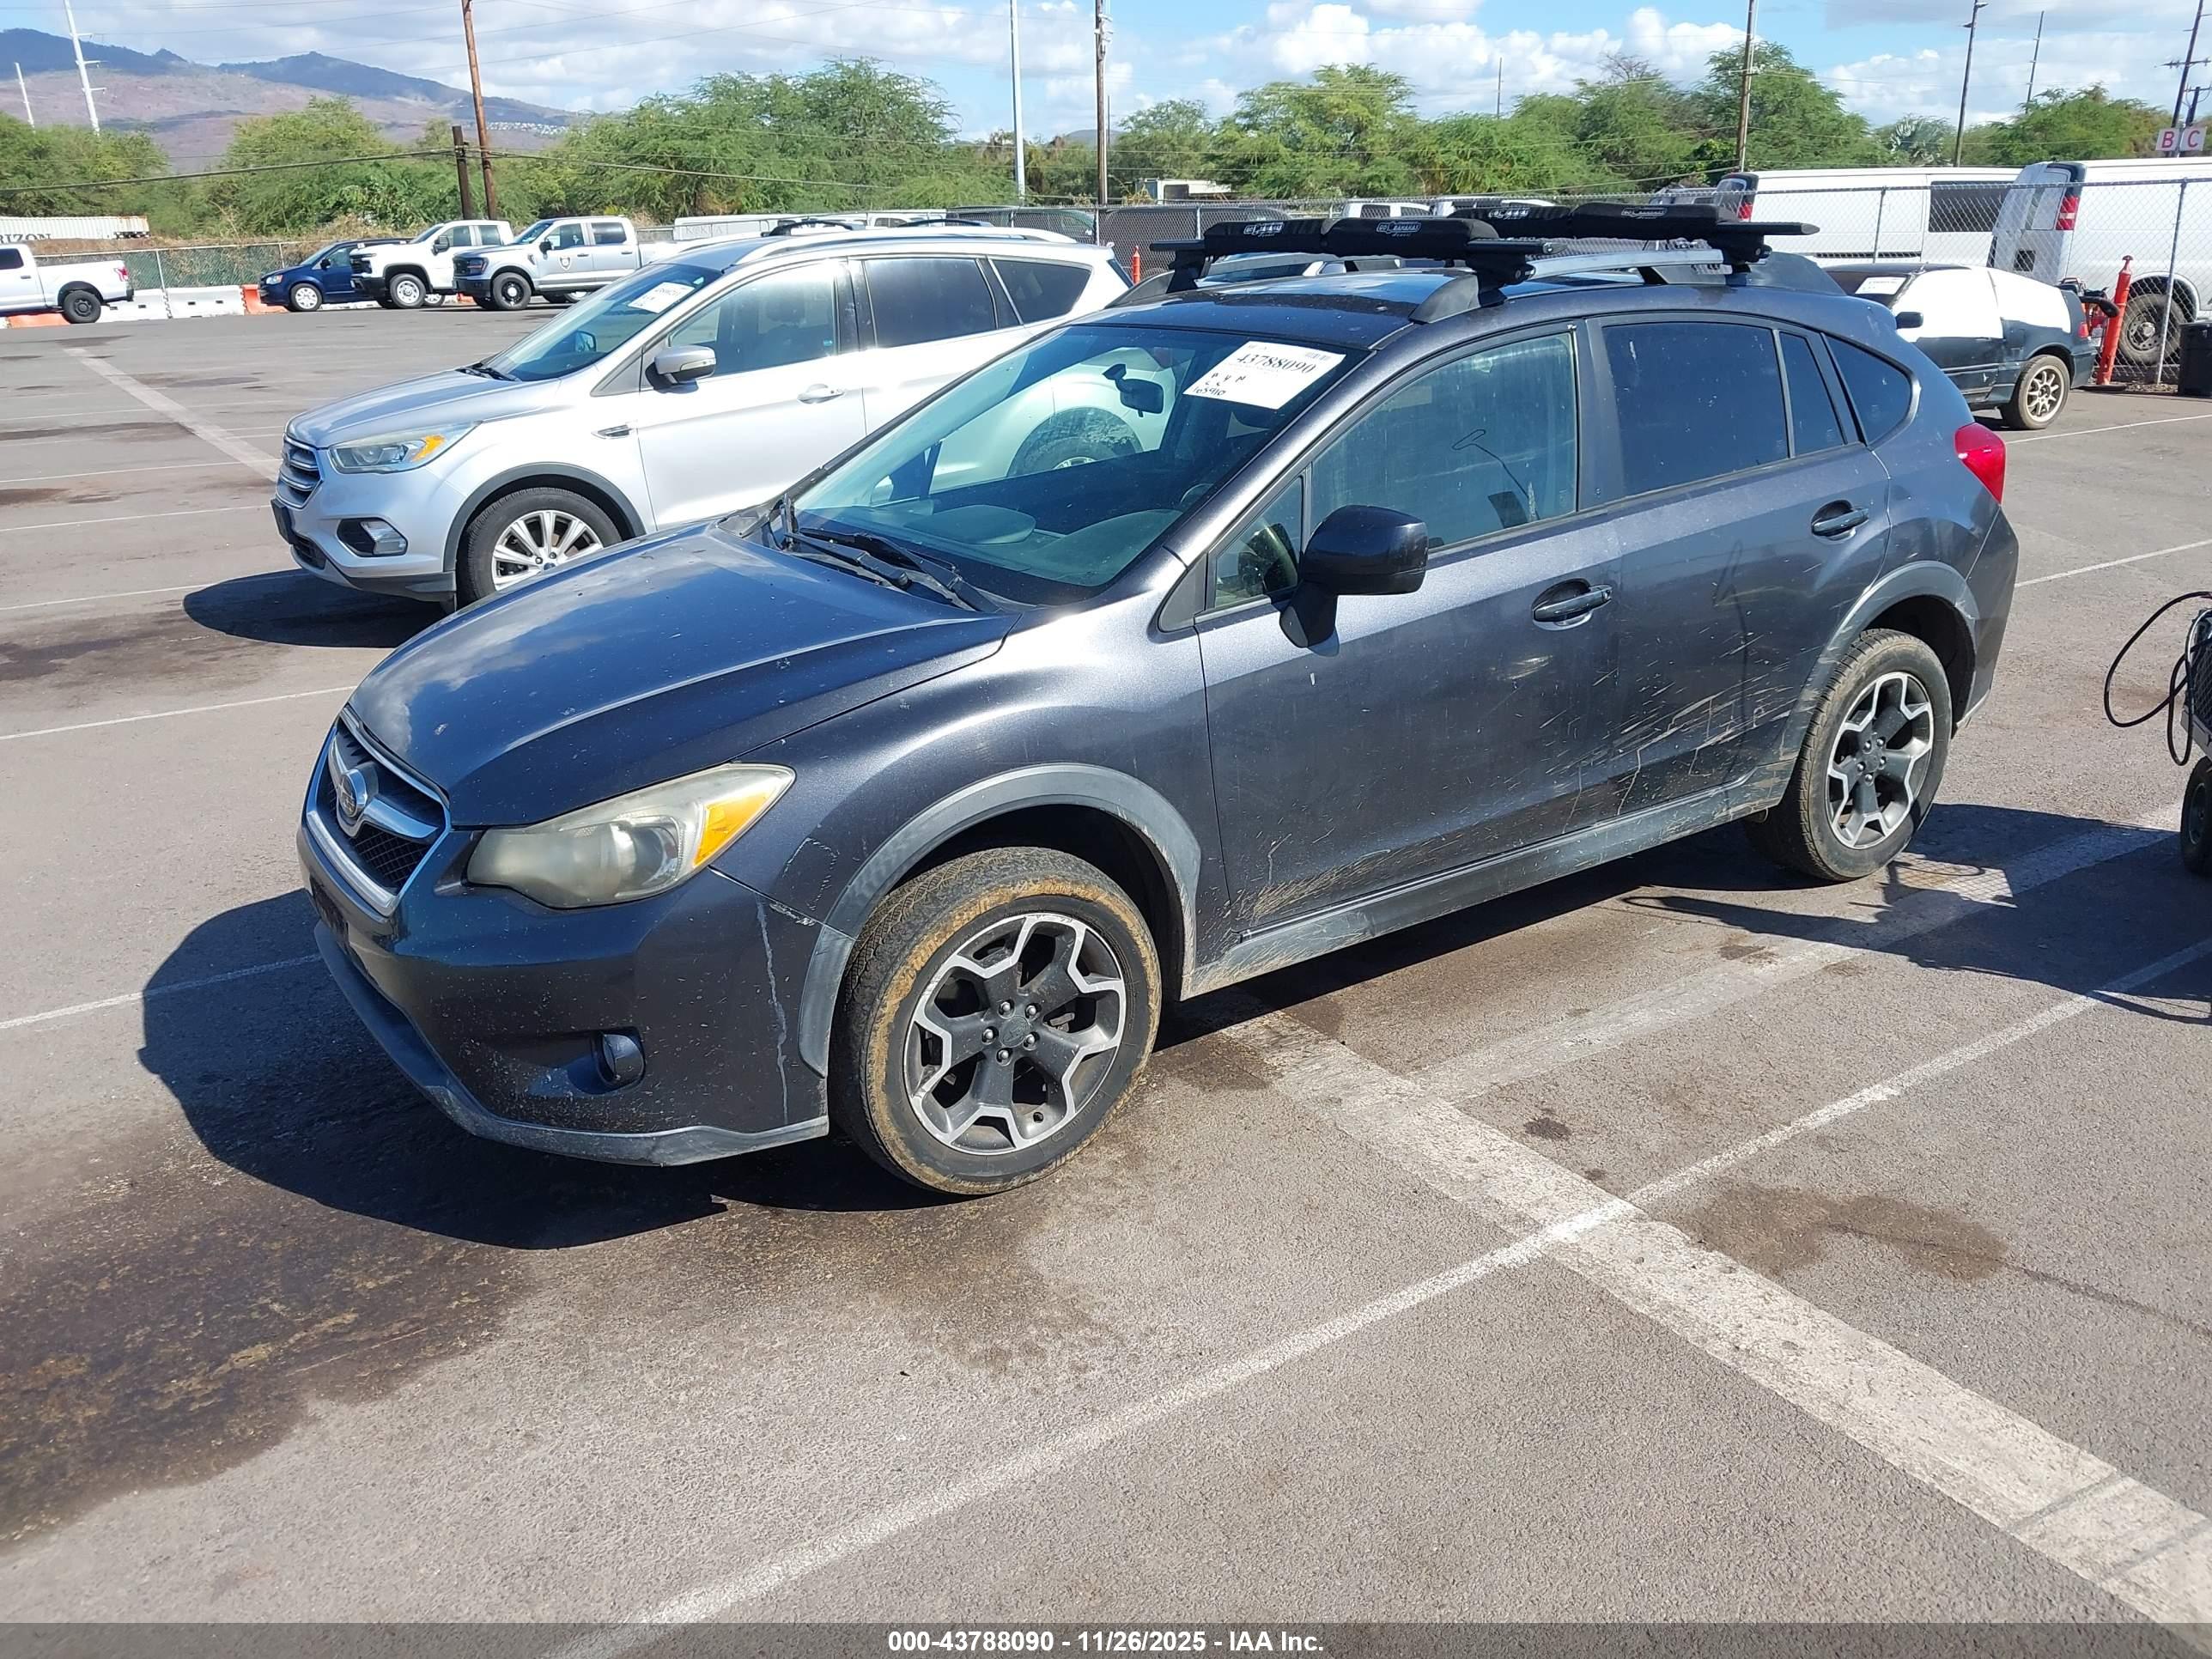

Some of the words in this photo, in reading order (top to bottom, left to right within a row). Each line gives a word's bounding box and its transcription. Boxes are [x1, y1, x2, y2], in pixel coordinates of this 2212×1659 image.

[2161, 131, 2174, 148] B
[2188, 130, 2200, 148] C
[1237, 353, 1316, 374] 43788090
